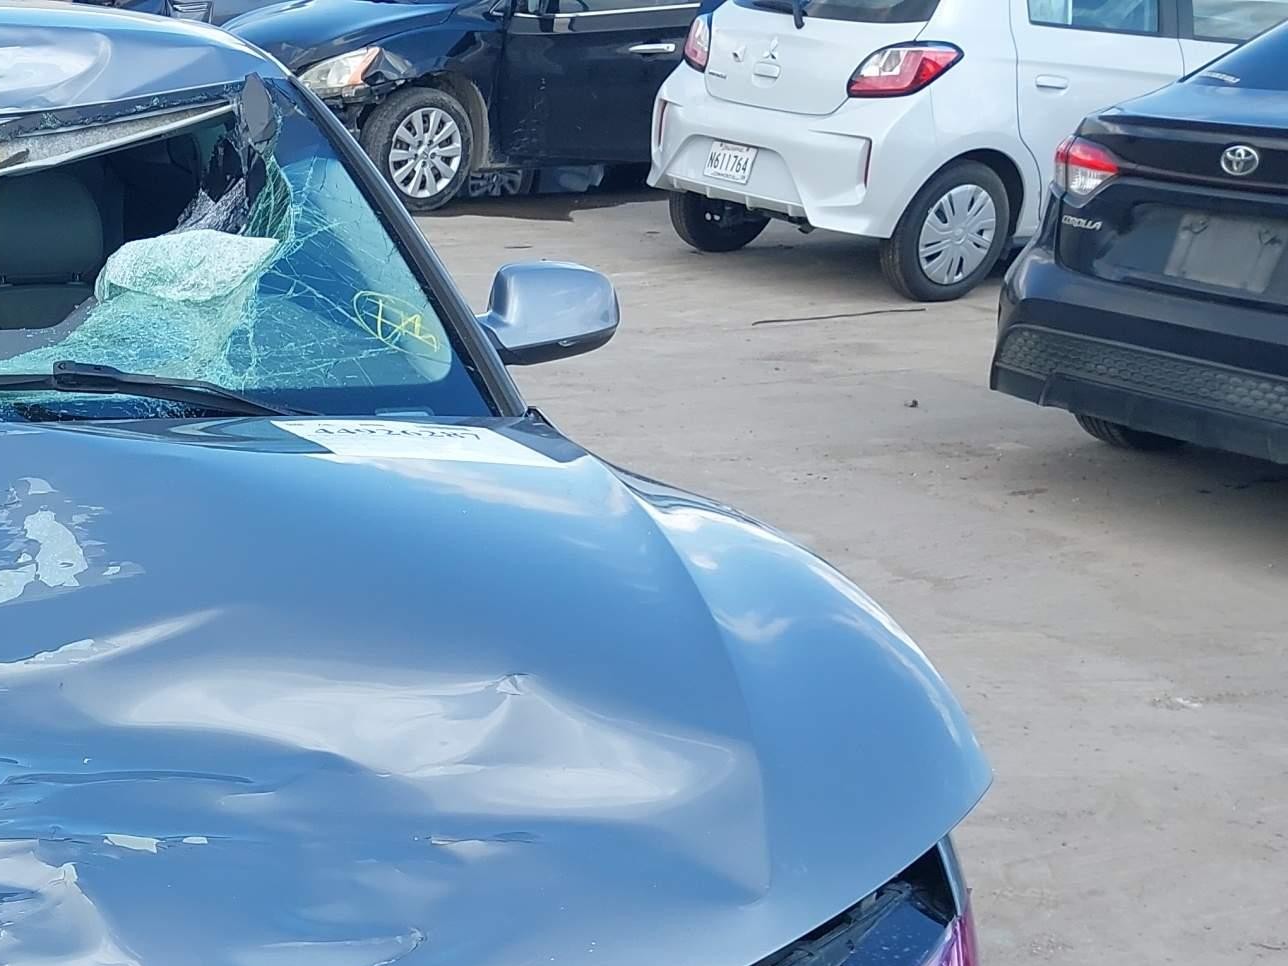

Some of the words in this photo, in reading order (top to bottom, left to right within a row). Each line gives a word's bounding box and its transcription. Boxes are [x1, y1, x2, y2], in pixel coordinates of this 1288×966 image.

[707, 151, 750, 174] N611764
[1062, 214, 1103, 231] COROLLA
[314, 426, 481, 441] 44926287
